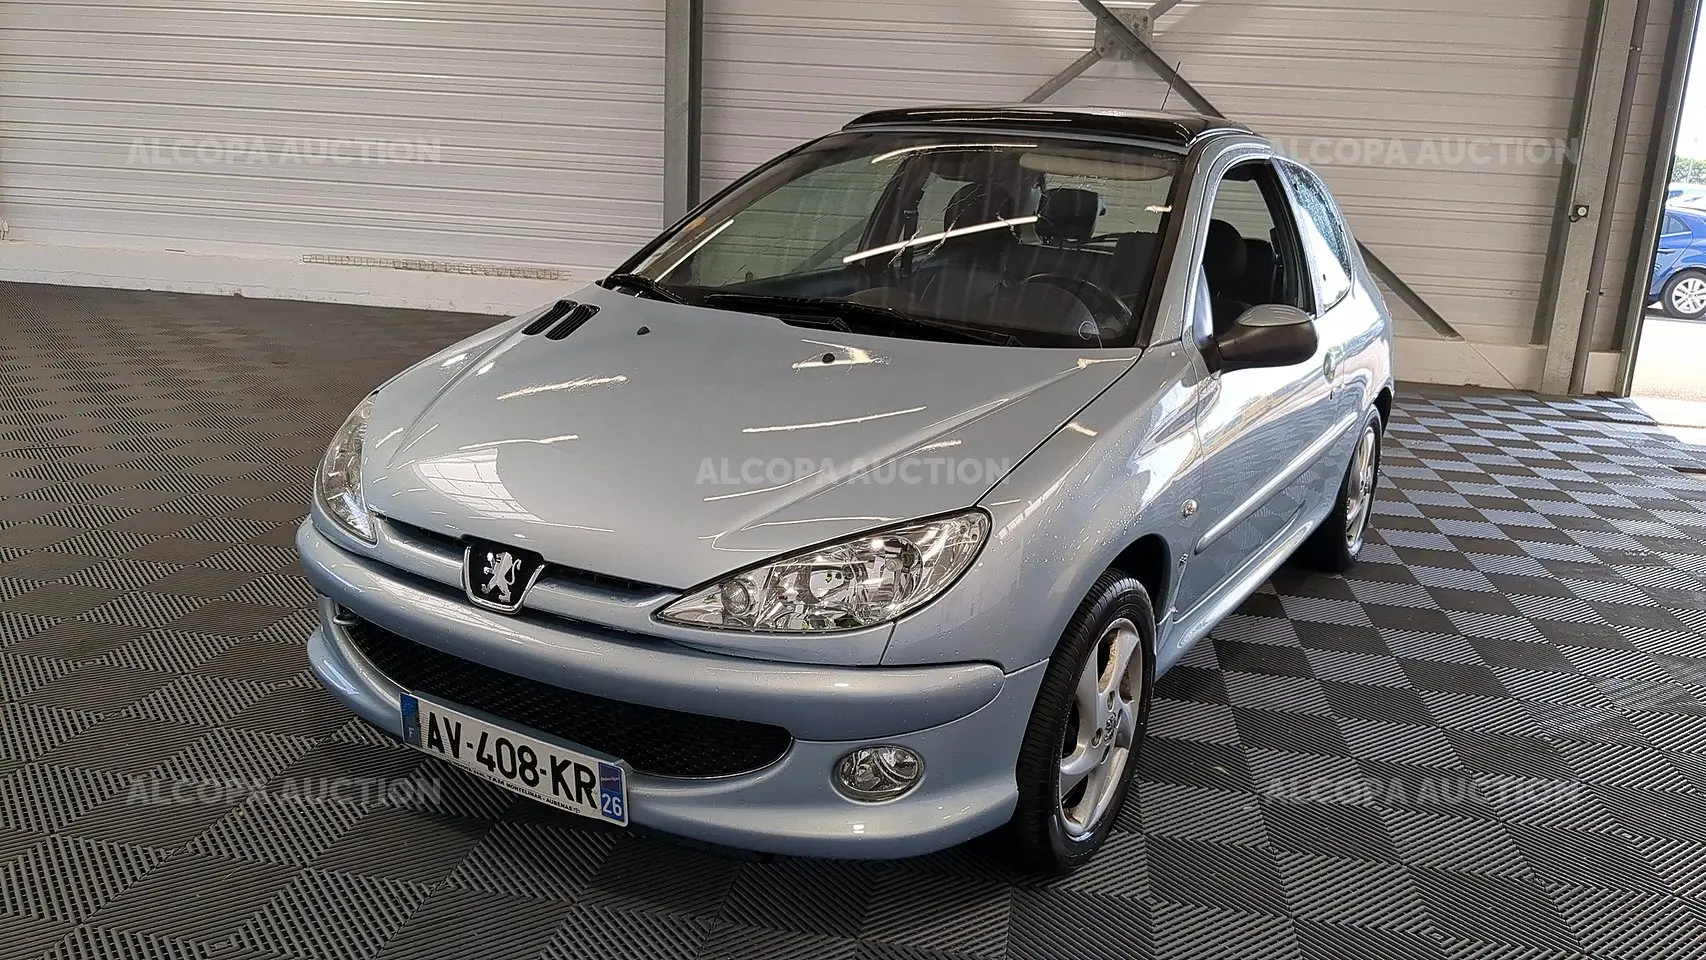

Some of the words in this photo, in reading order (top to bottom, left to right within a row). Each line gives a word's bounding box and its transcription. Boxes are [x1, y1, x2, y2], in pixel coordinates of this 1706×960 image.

[408, 727, 415, 738] F
[427, 711, 598, 810] AV-408-KR
[506, 782, 542, 801] MONTELIMAR
[546, 797, 573, 811] AUBENAS
[602, 793, 622, 817] 26
